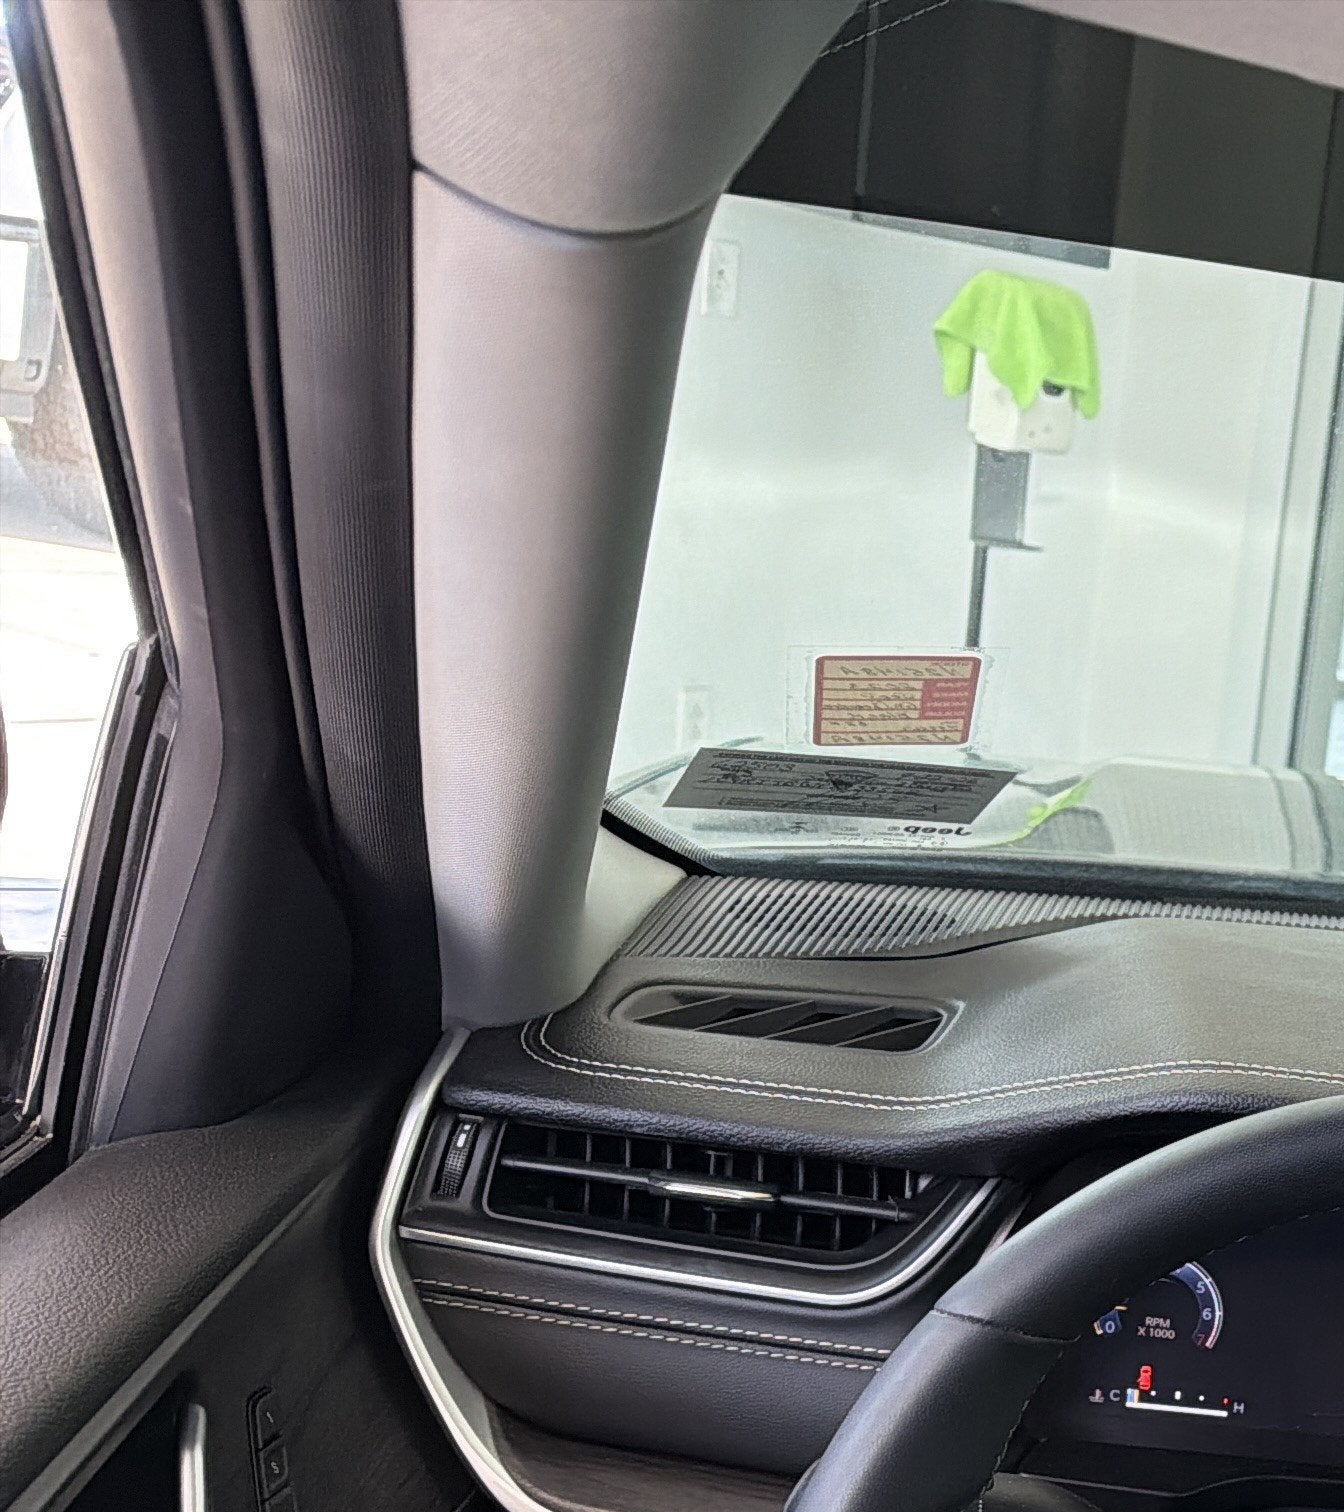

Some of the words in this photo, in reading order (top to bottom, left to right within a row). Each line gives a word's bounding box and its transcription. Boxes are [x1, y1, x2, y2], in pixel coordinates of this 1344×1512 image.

[1196, 1281, 1206, 1294] 5
[1202, 1307, 1212, 1321] 6
[1104, 1320, 1116, 1334] 0
[1144, 1316, 1171, 1329] RPM
[1137, 1327, 1147, 1337] X
[1149, 1327, 1176, 1340] 1000
[1110, 1390, 1120, 1401] C
[1232, 1401, 1246, 1415] H
